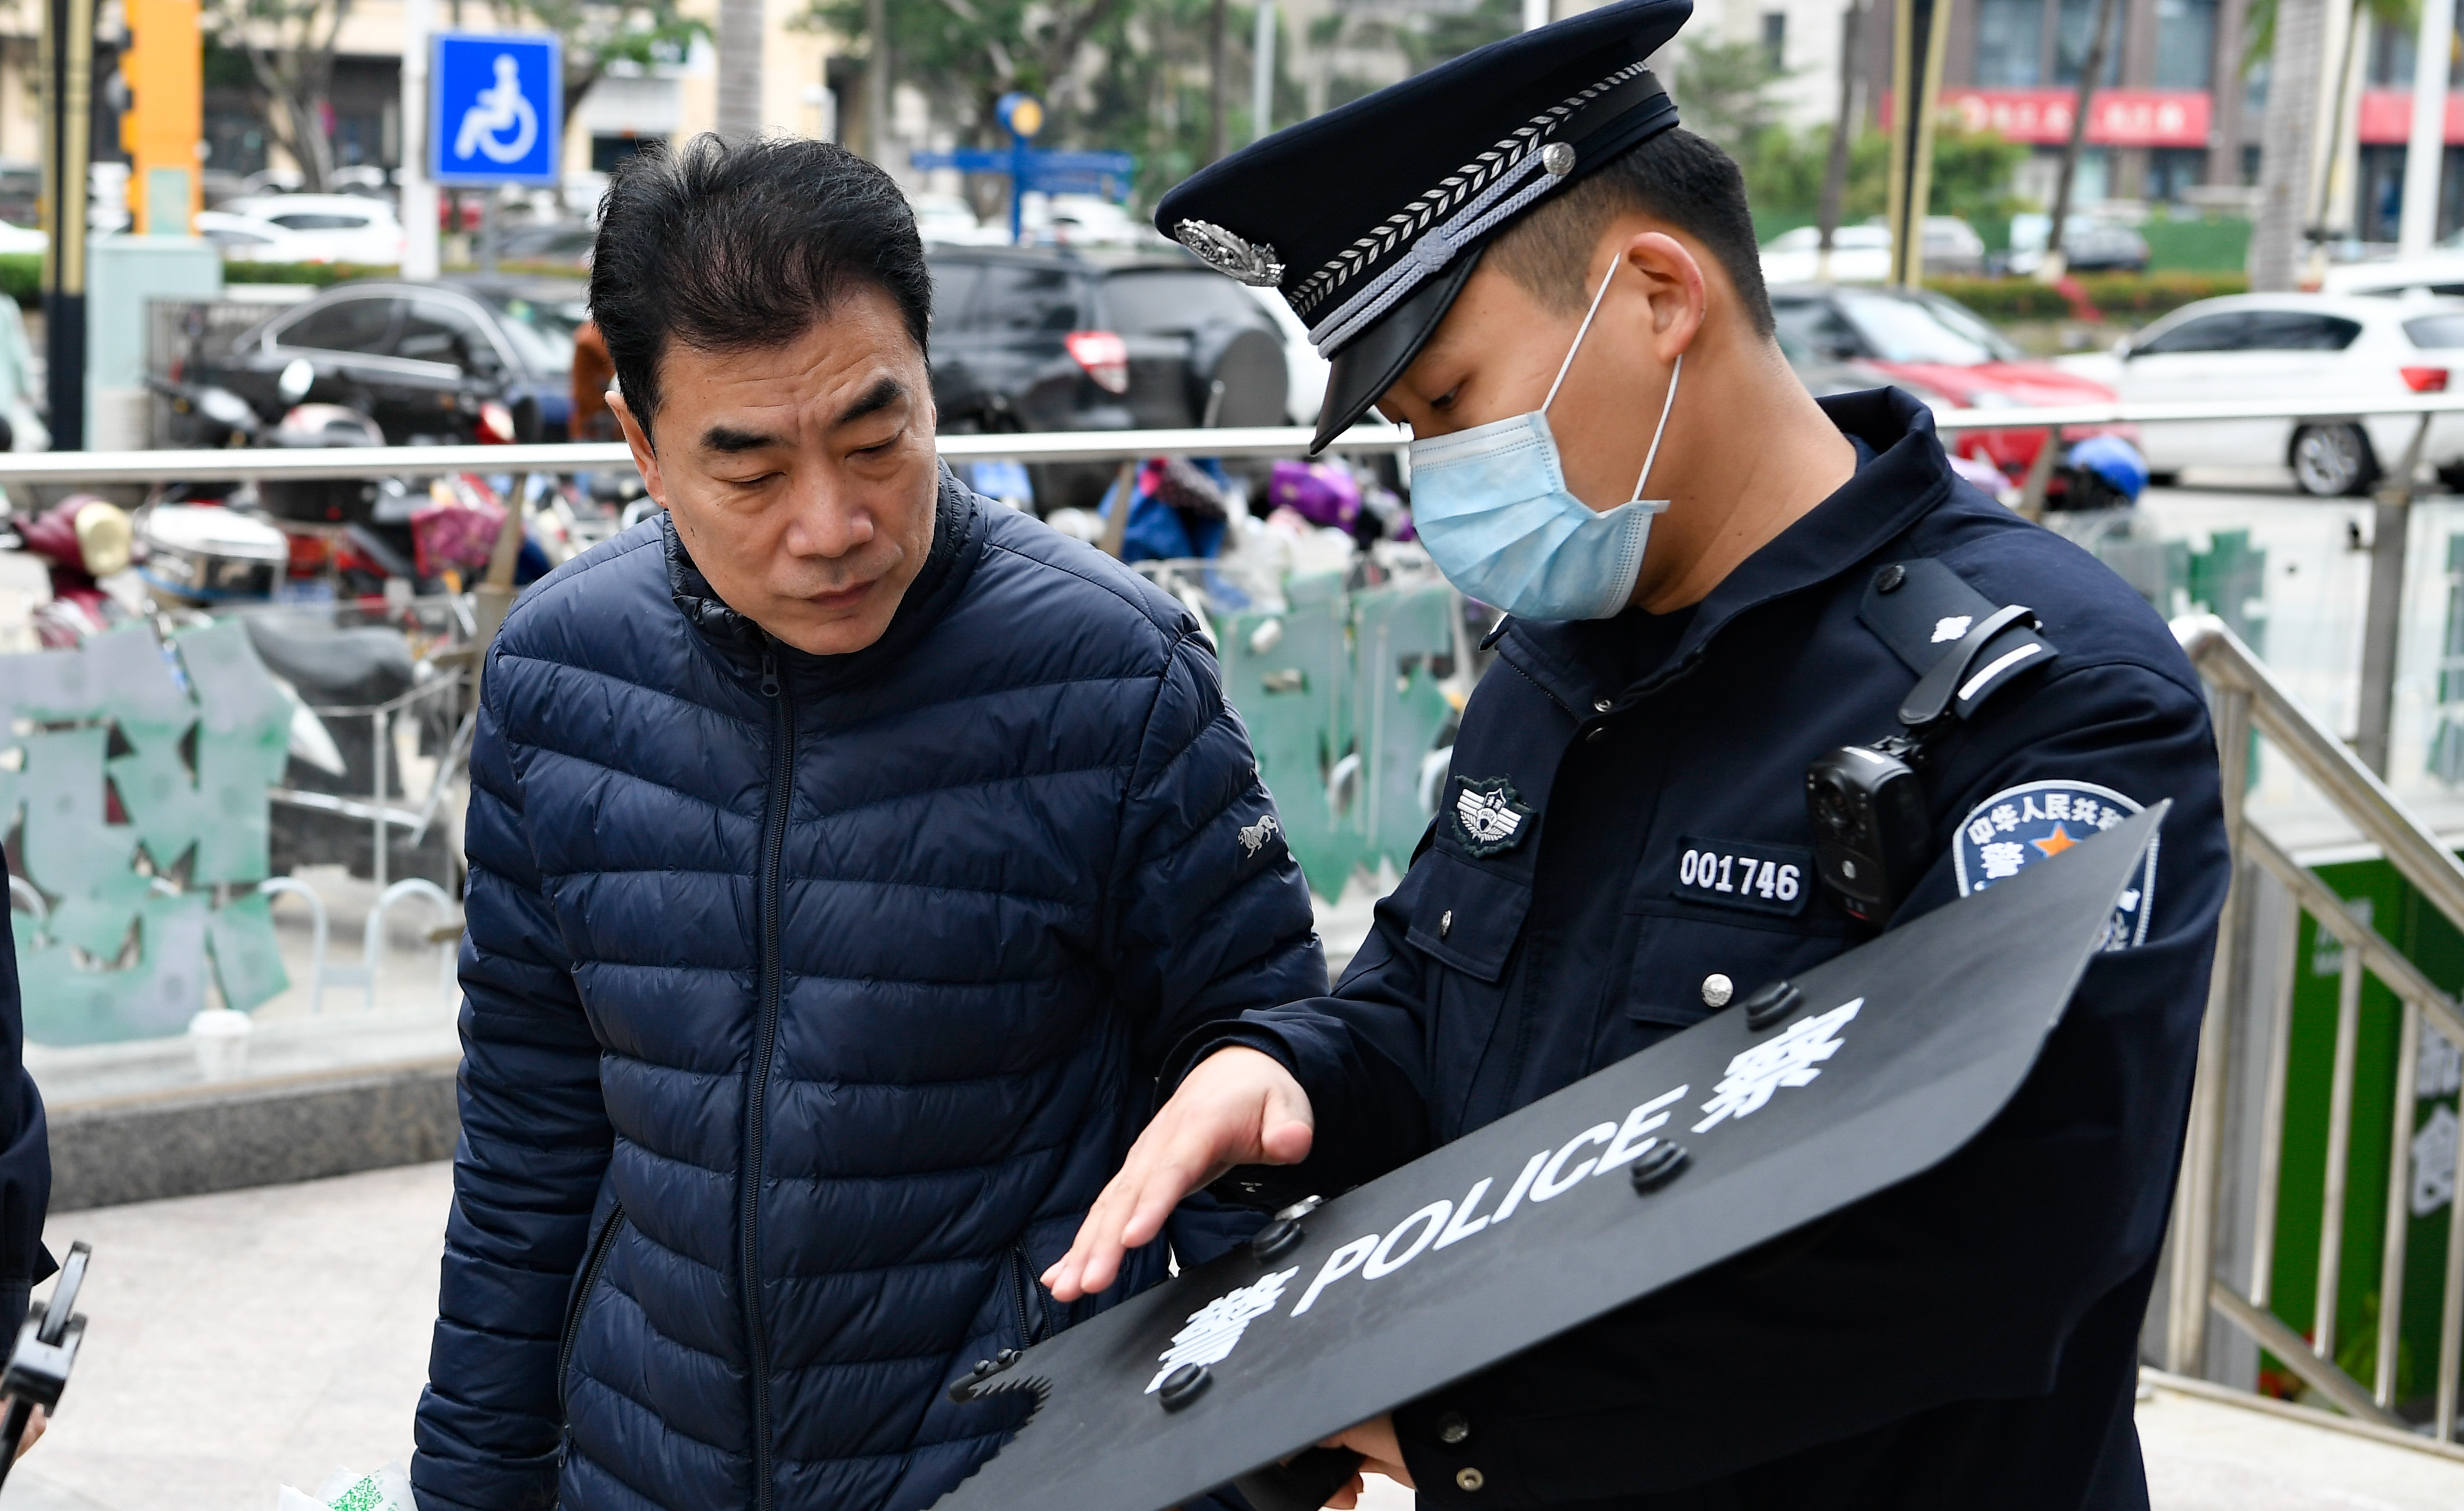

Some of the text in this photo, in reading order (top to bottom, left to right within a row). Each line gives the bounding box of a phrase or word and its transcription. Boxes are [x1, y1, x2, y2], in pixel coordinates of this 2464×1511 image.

[1680, 849, 1800, 901] 001746
[1980, 841, 2025, 879] 警
[1290, 1084, 1689, 1317] POLICE
[1690, 997, 1865, 1134] 察
